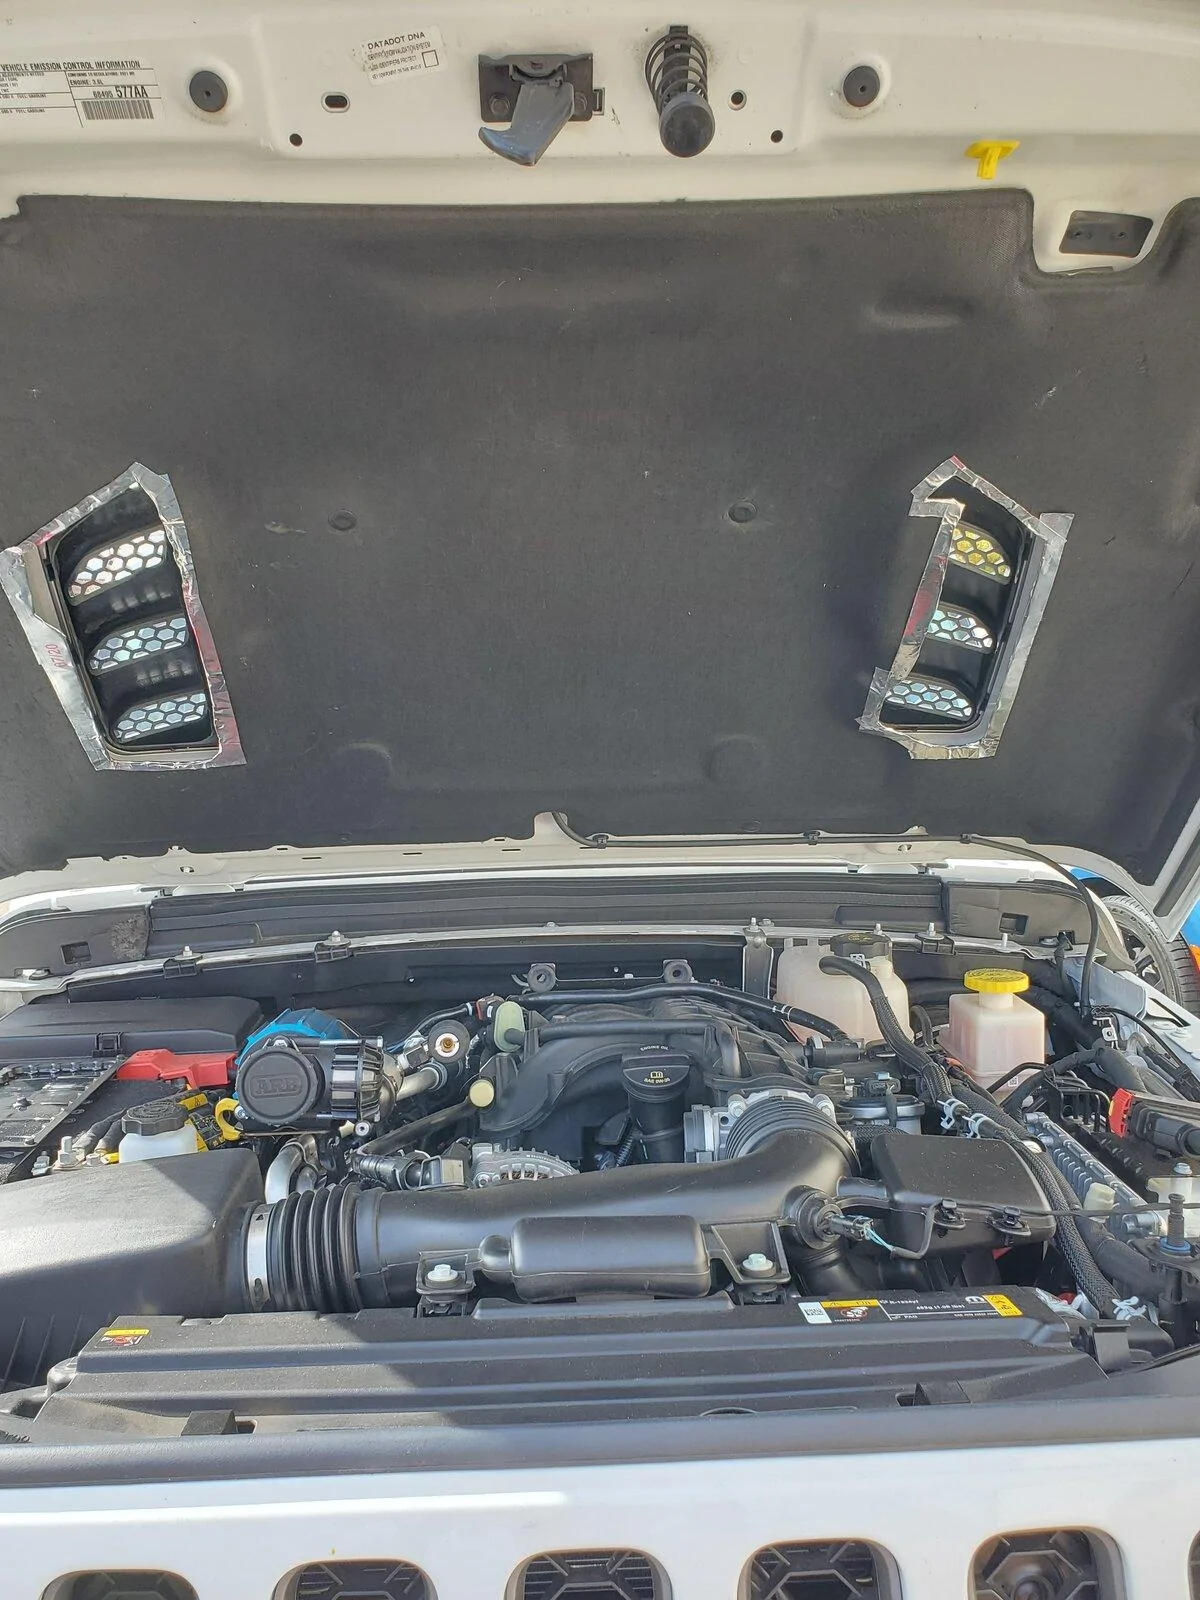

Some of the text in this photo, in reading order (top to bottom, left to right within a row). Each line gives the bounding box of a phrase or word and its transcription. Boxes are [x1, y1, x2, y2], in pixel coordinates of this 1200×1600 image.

[367, 32, 426, 50] DATADOT DNA
[0, 60, 142, 72] VEHICLE EMISSION CONTROL INFORMATION
[114, 85, 149, 98] 577AA
